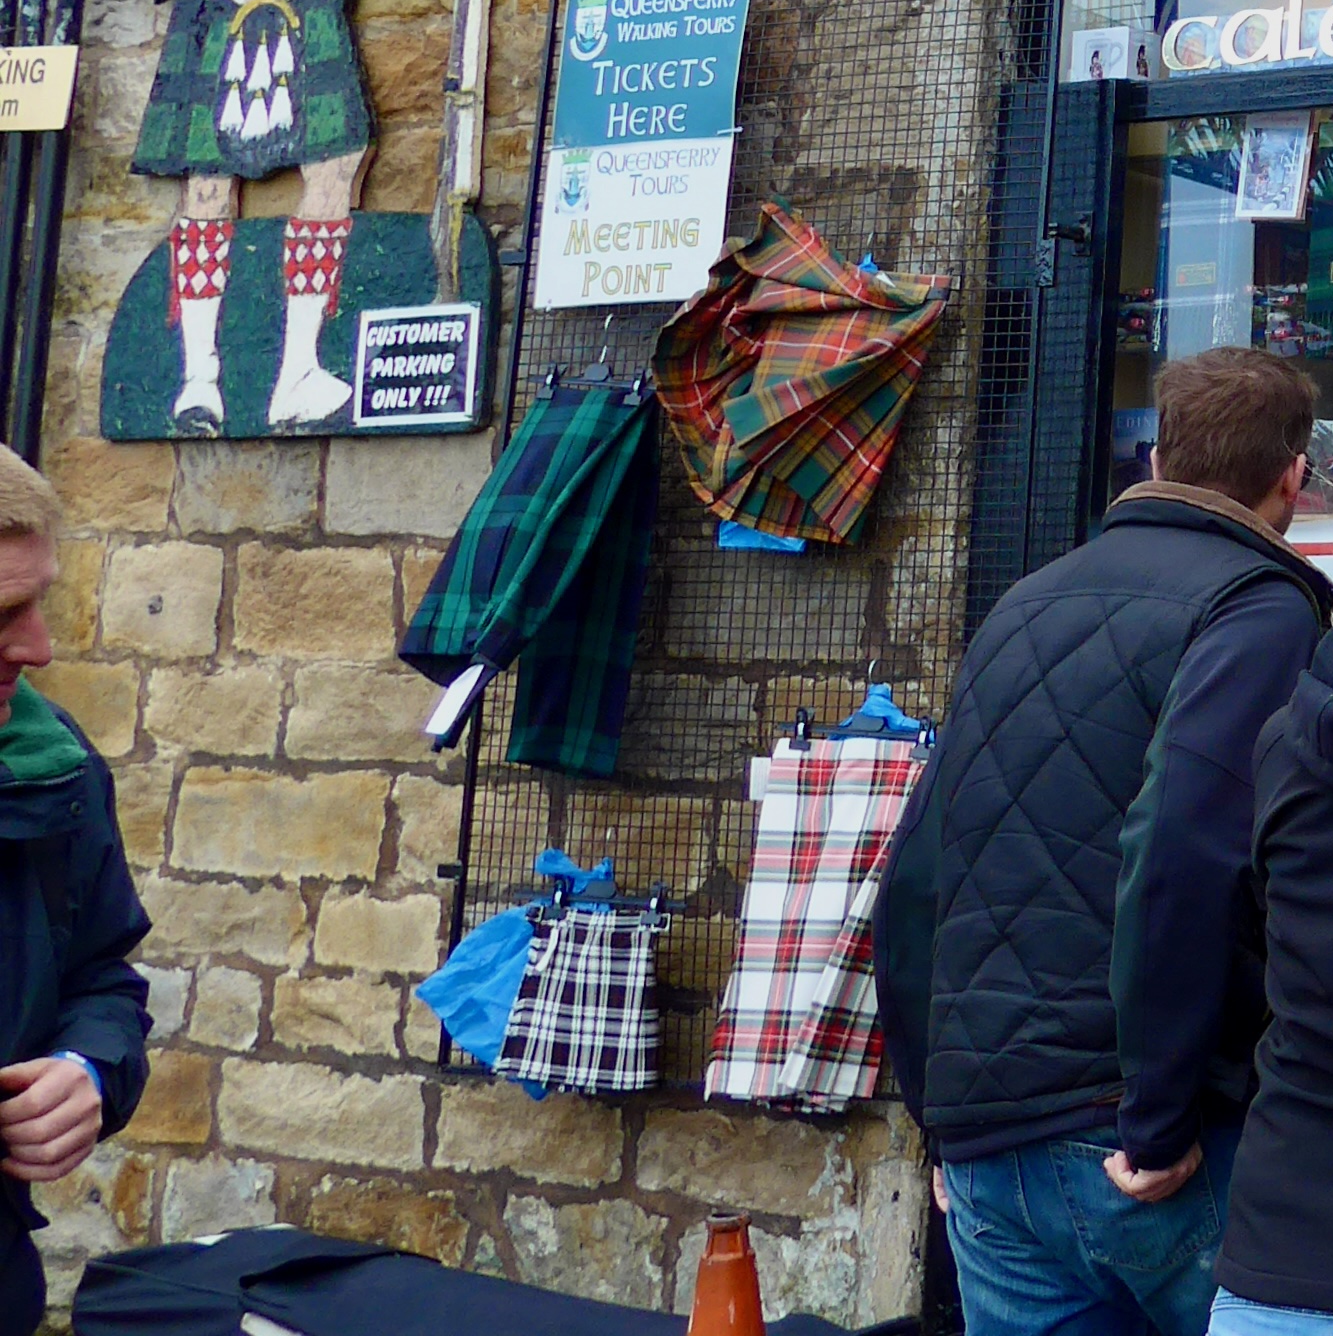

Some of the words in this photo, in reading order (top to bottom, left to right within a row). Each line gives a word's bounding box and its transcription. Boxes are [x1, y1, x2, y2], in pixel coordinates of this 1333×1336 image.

[366, 321, 466, 347] CUSTOMER
[370, 353, 455, 378] PARKING
[371, 386, 422, 410] ONLY
